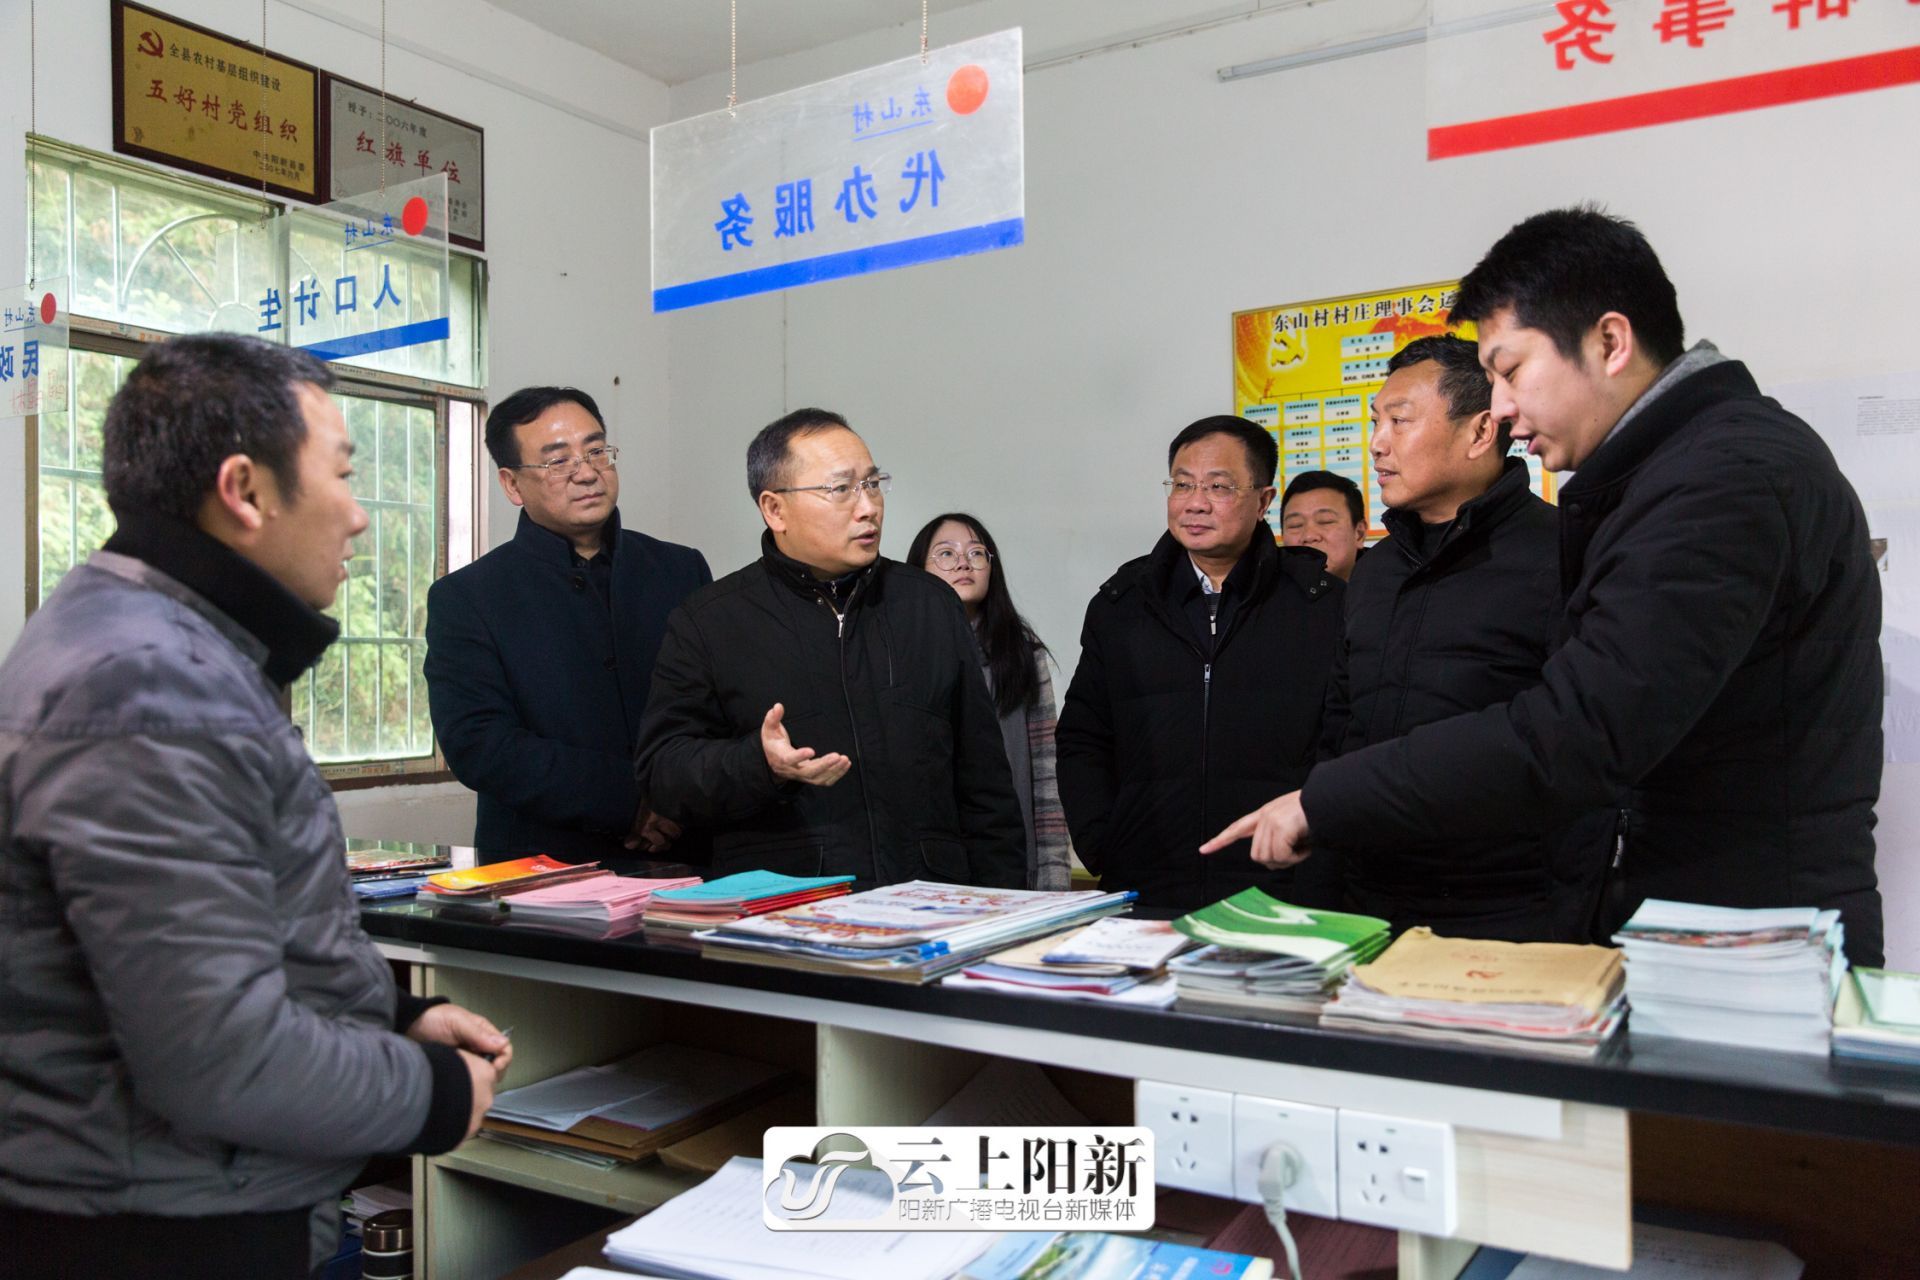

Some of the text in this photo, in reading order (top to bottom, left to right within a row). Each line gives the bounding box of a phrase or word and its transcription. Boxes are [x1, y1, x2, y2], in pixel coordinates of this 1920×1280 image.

[169, 43, 281, 92] 全县农村基层组织建设
[146, 79, 298, 143] 五好村党组织
[356, 130, 461, 184] 红旗单位
